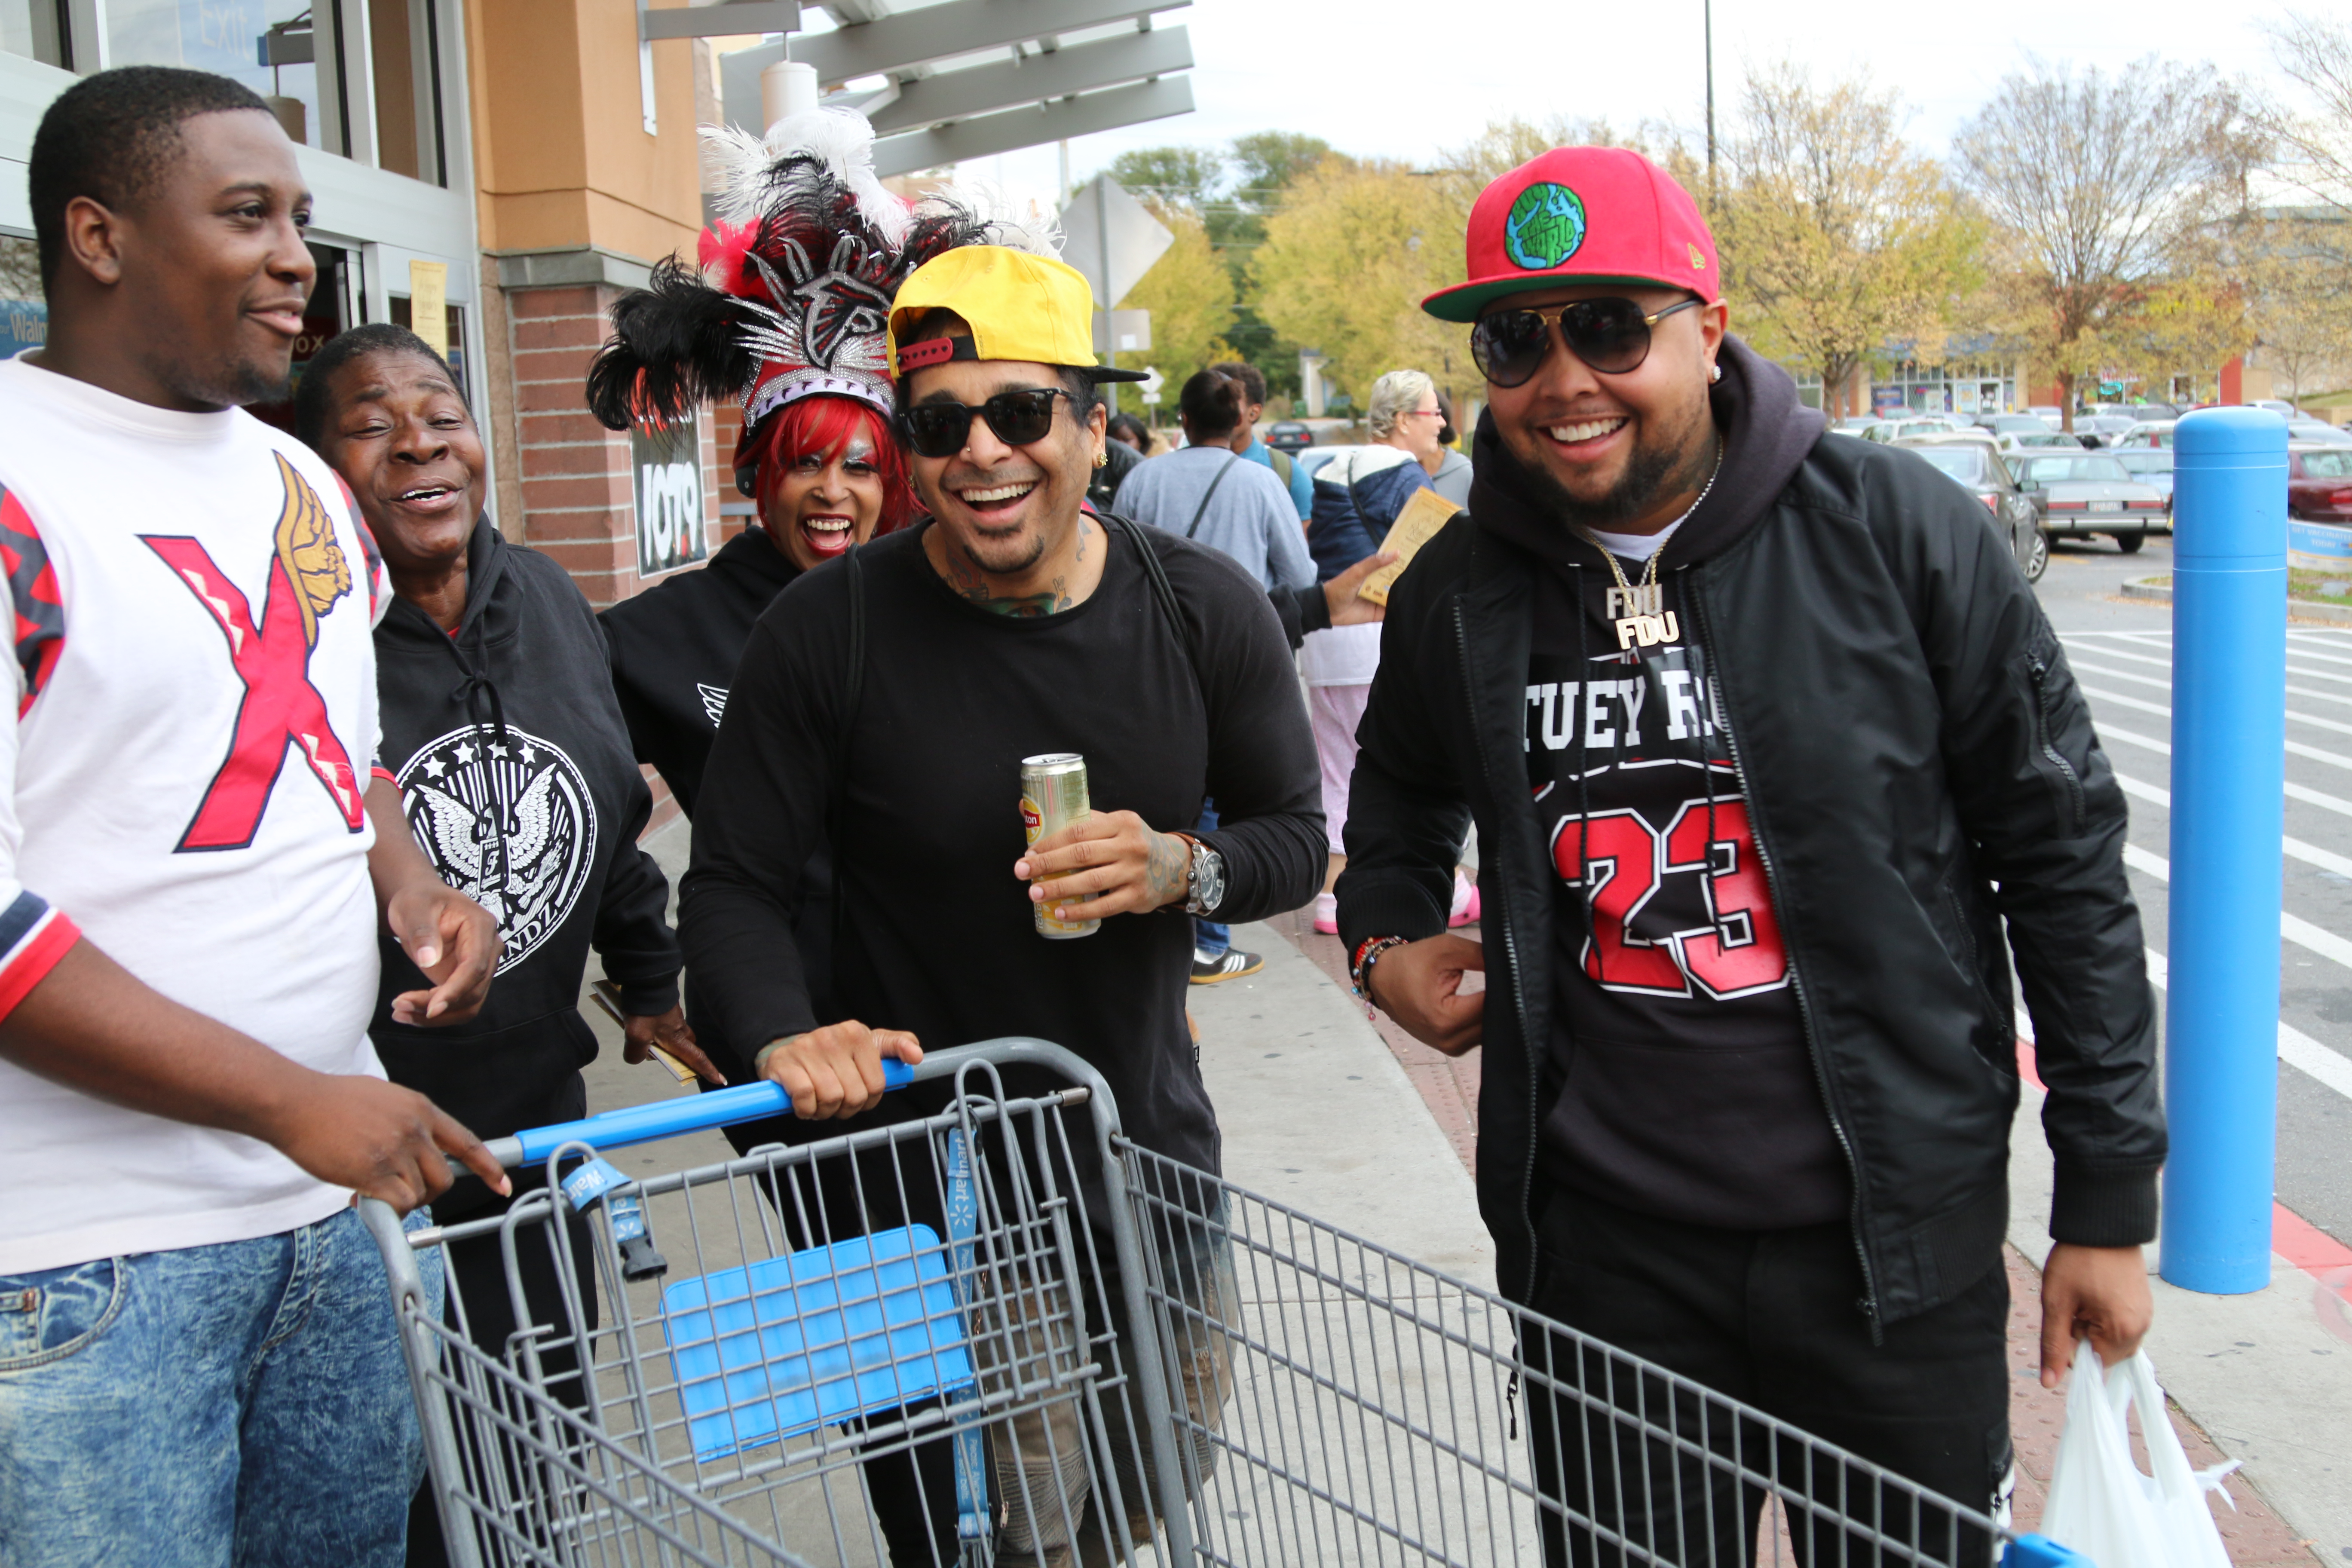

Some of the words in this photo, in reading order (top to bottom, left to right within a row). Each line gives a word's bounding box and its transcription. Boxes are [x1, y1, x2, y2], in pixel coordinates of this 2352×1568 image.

[1512, 184, 1550, 226] BUY
[1518, 211, 1556, 239] THE
[1522, 214, 1575, 268] WORLD
[2292, 526, 2306, 534] GET
[2312, 539, 2337, 548] TODAY
[1607, 583, 1663, 619] FDU
[1615, 610, 1680, 649] FDU
[1549, 794, 1792, 1001] 23
